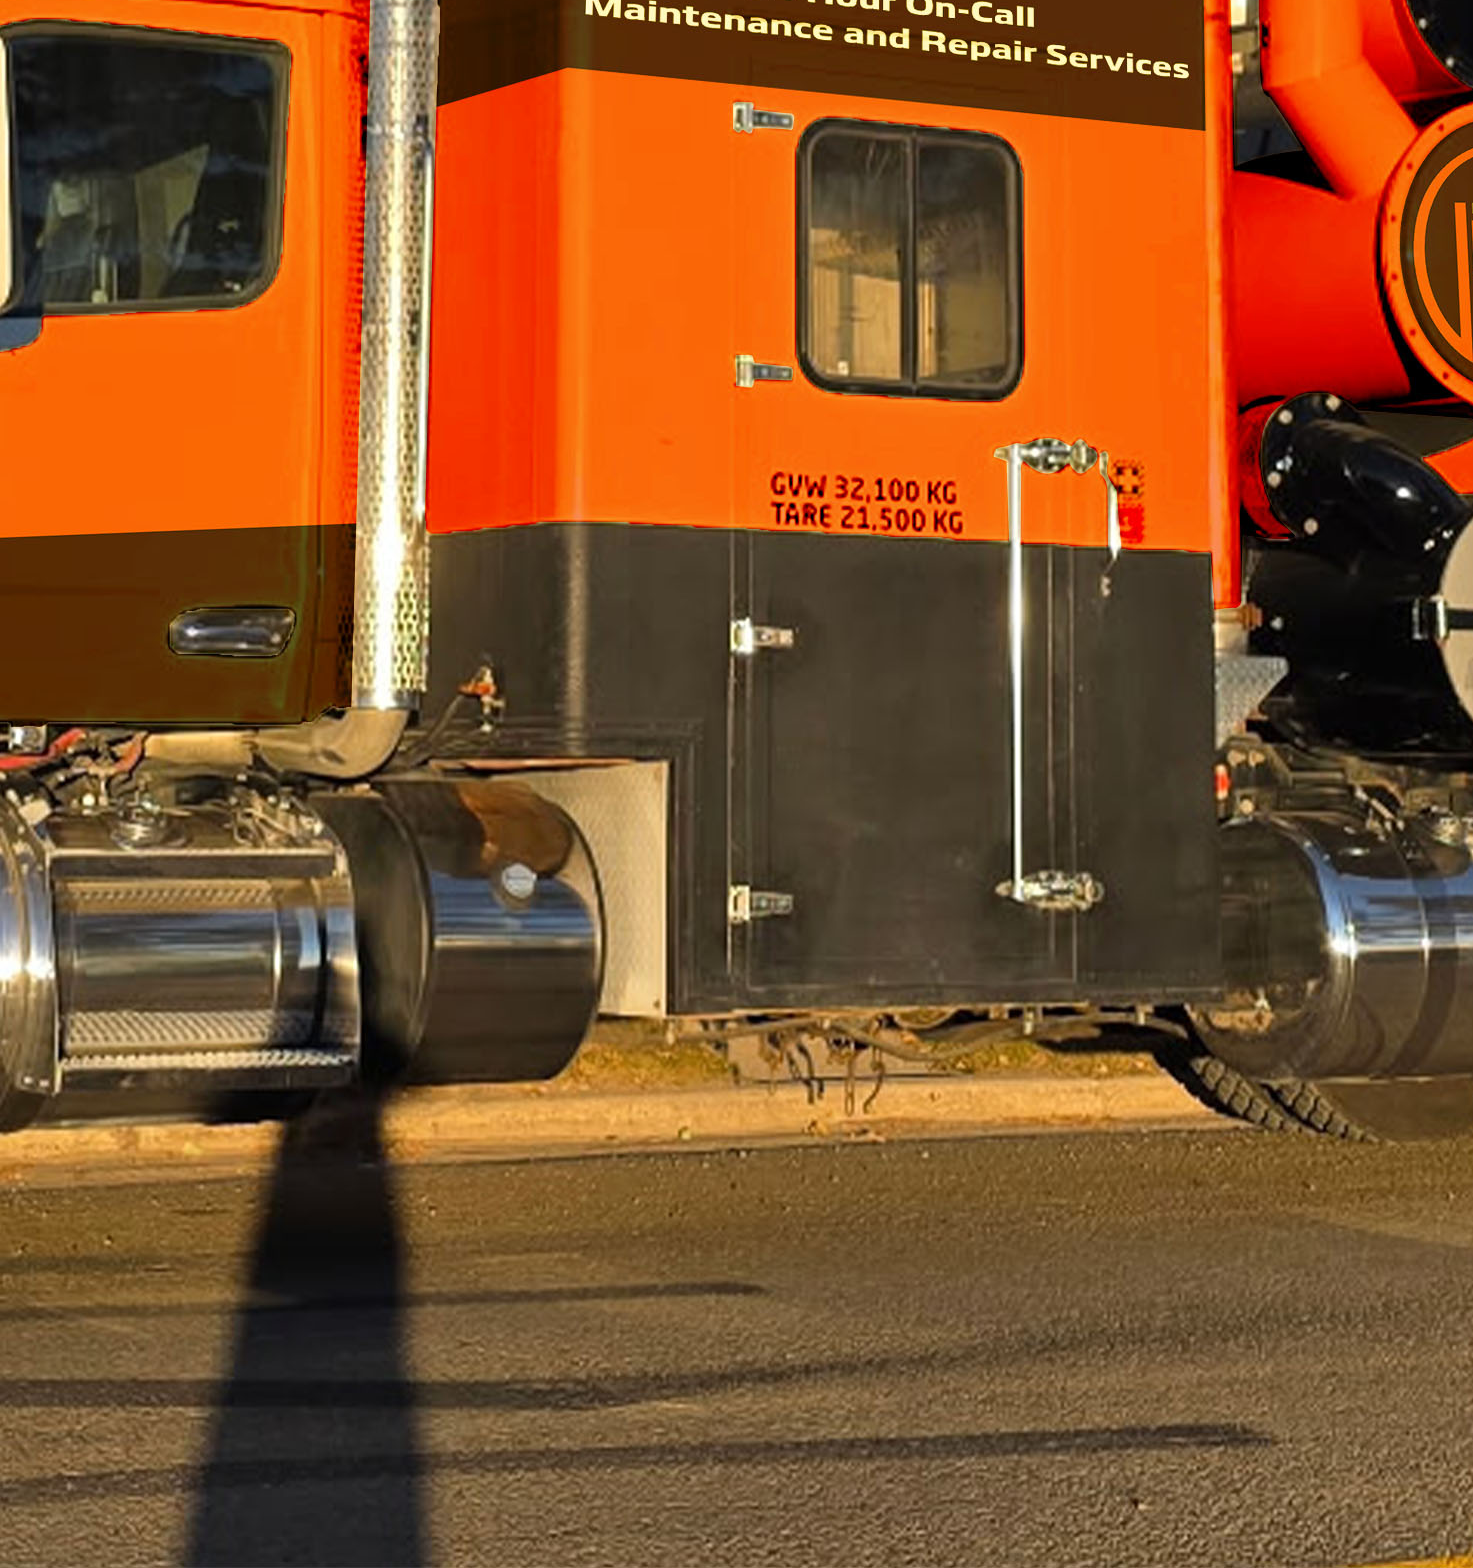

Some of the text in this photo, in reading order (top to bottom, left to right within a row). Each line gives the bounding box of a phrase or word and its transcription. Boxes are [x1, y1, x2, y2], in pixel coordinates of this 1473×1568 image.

[843, 26, 910, 50] and
[921, 30, 1037, 63] Repair
[1046, 44, 1190, 79] Services
[771, 472, 957, 505] GVW 32,100 KG
[771, 502, 963, 534] TARE 21,500 KG
